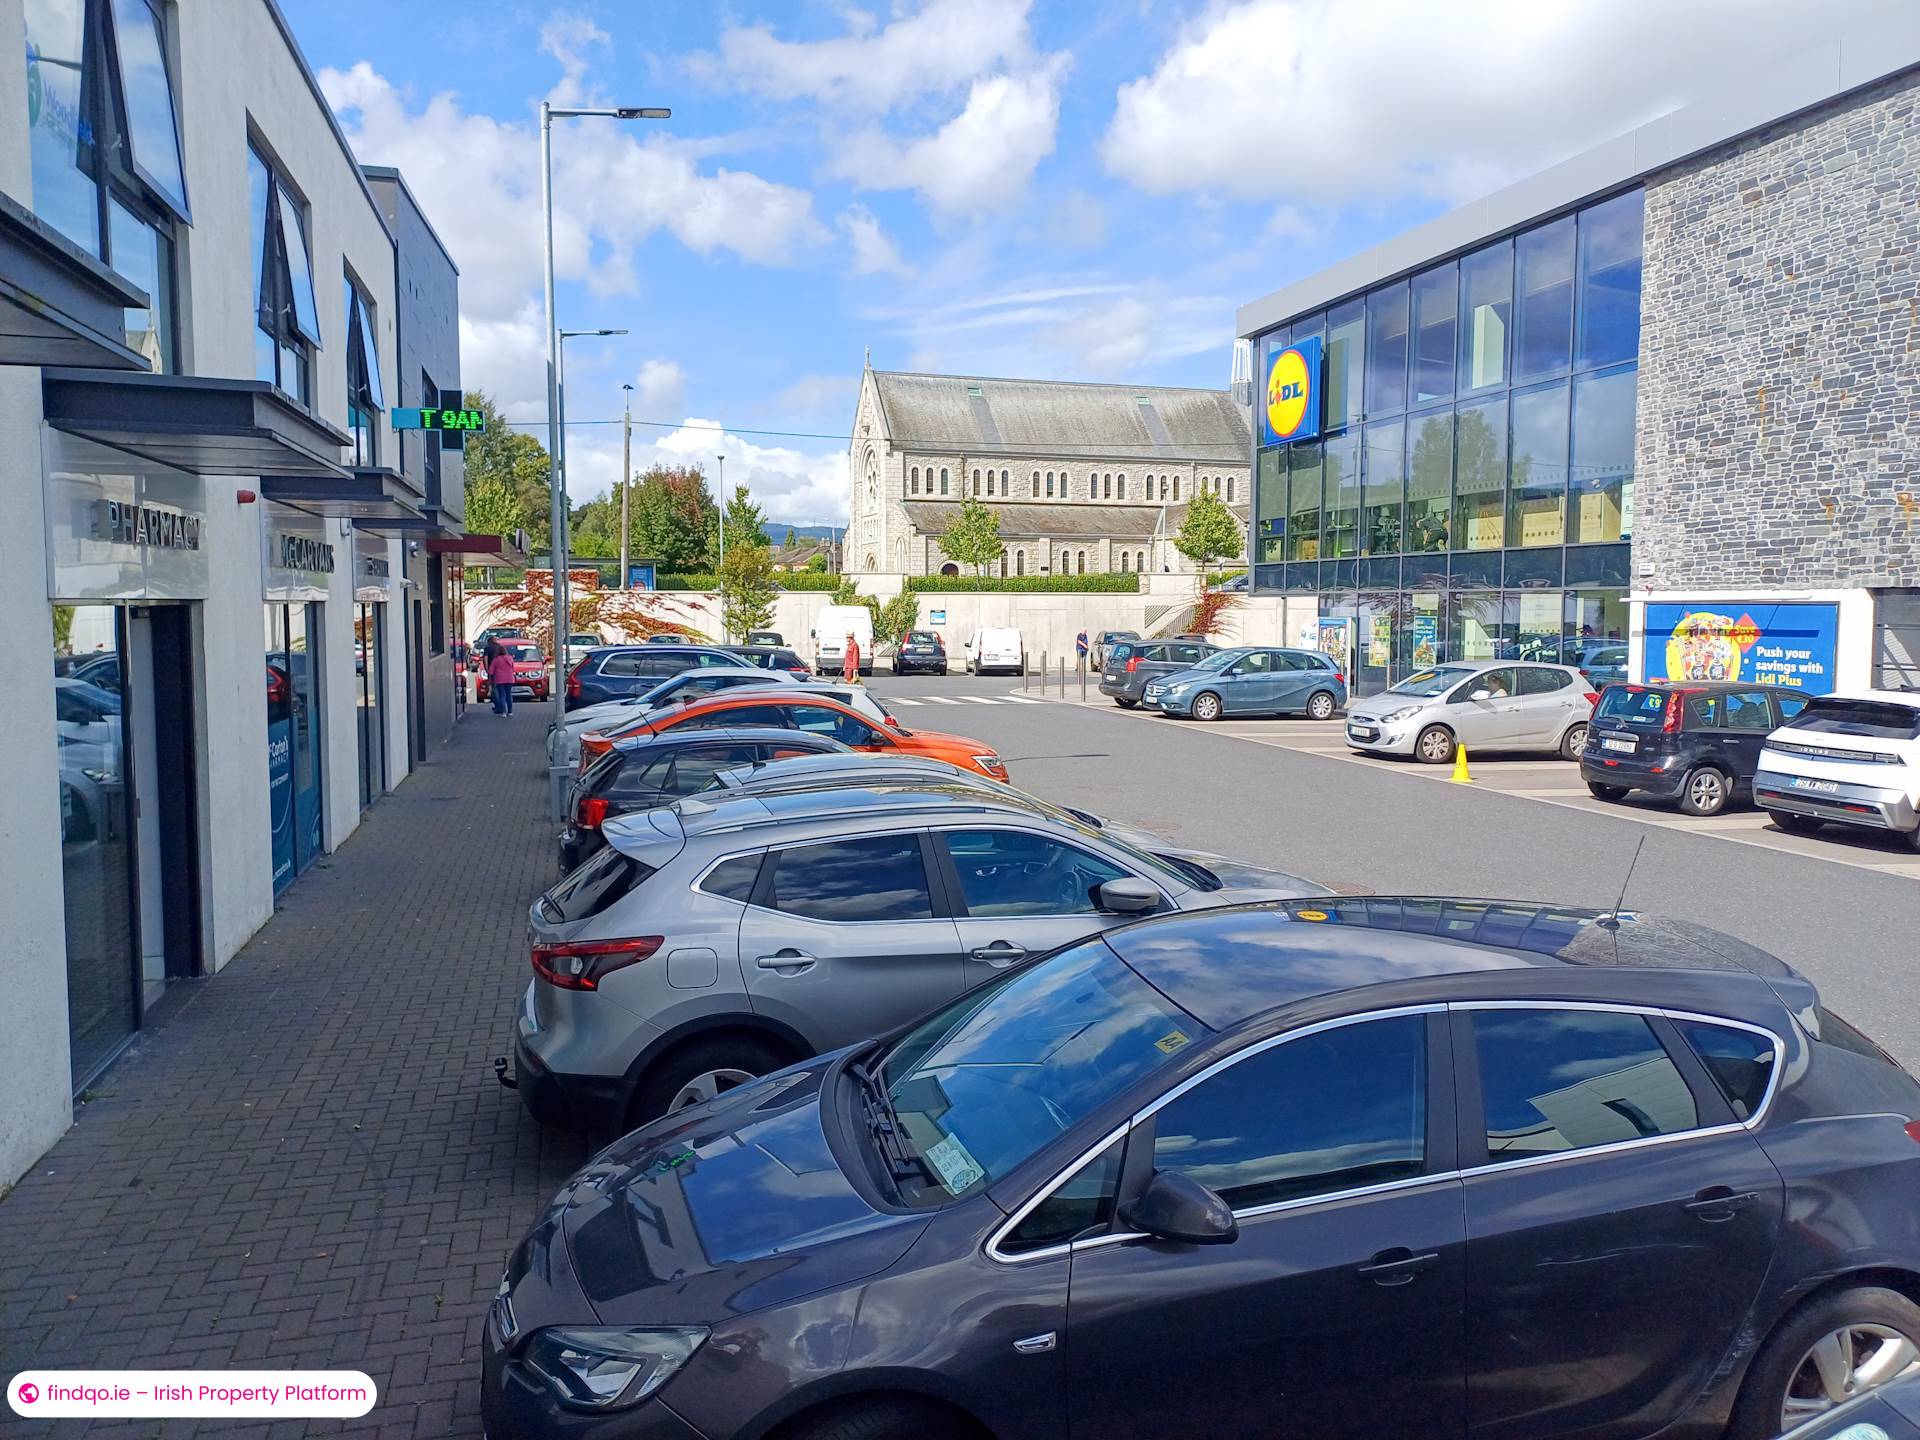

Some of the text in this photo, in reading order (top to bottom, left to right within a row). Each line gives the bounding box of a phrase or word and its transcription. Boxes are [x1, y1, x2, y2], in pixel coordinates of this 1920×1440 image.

[420, 409, 437, 428] T
[107, 499, 200, 550] PHARMACY
[1734, 624, 1756, 634] Save
[1737, 633, 1754, 644] €30
[1756, 646, 1812, 660] Push your
[1755, 661, 1824, 675] savings with
[1755, 673, 1803, 687] Lidl Plus
